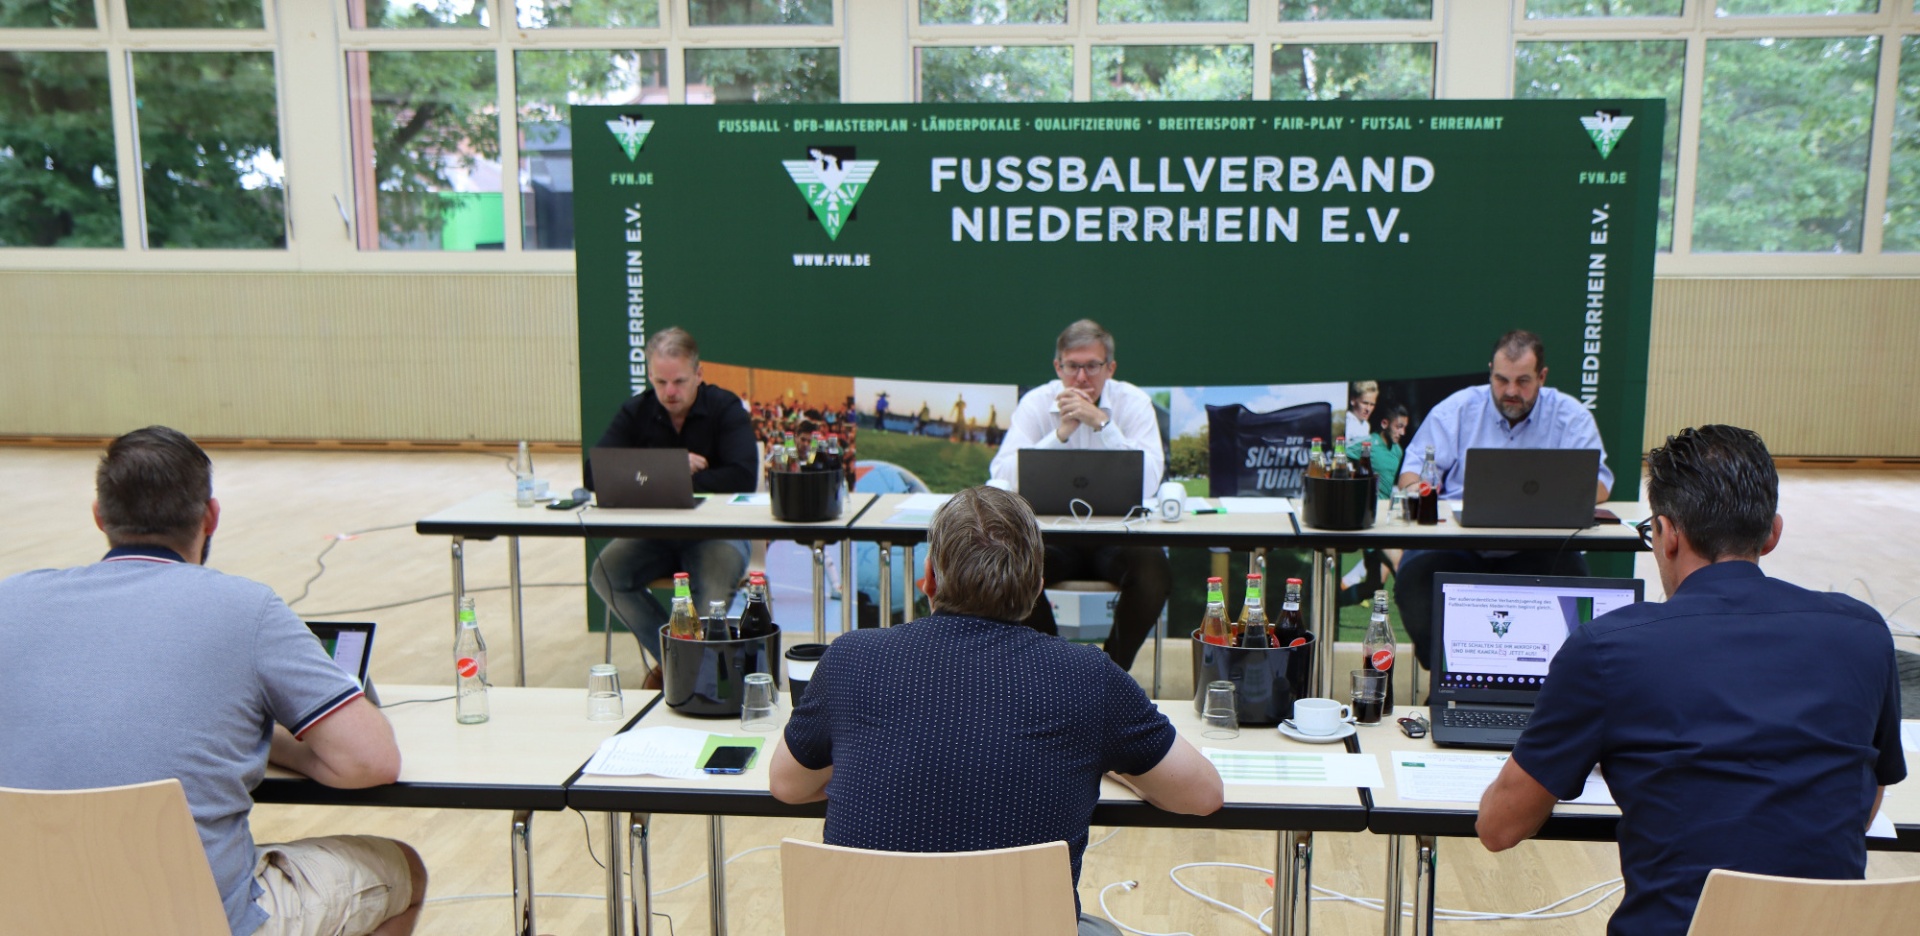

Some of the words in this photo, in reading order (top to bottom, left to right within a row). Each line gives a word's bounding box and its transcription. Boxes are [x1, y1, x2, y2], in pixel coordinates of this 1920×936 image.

[718, 119, 780, 132] FUSSBALL
[793, 118, 908, 132] DFB-MASTERPLAN
[921, 115, 1021, 132] LÄNDERPOKALE
[1034, 117, 1141, 132] QUALIFIZIERUNG
[1158, 117, 1256, 131] BREITENSPORT
[1273, 116, 1344, 130] FAIR-PLAY
[1361, 116, 1412, 130] FUTSAL
[1430, 116, 1504, 130] EHRENAMT
[610, 172, 654, 185] FVN.DE
[930, 156, 1435, 193] FUSSBALLVERBAND
[1579, 171, 1627, 184] FVN.DE
[625, 202, 643, 243] E.V.
[951, 206, 1299, 243] NIEDERRHEIN
[1321, 206, 1409, 243] E.V.
[1590, 203, 1610, 245] E.V.
[792, 254, 871, 267] WWW.FVN.DE
[1580, 253, 1607, 410] NIEDERRHEIN
[1256, 468, 1306, 490] TURN
